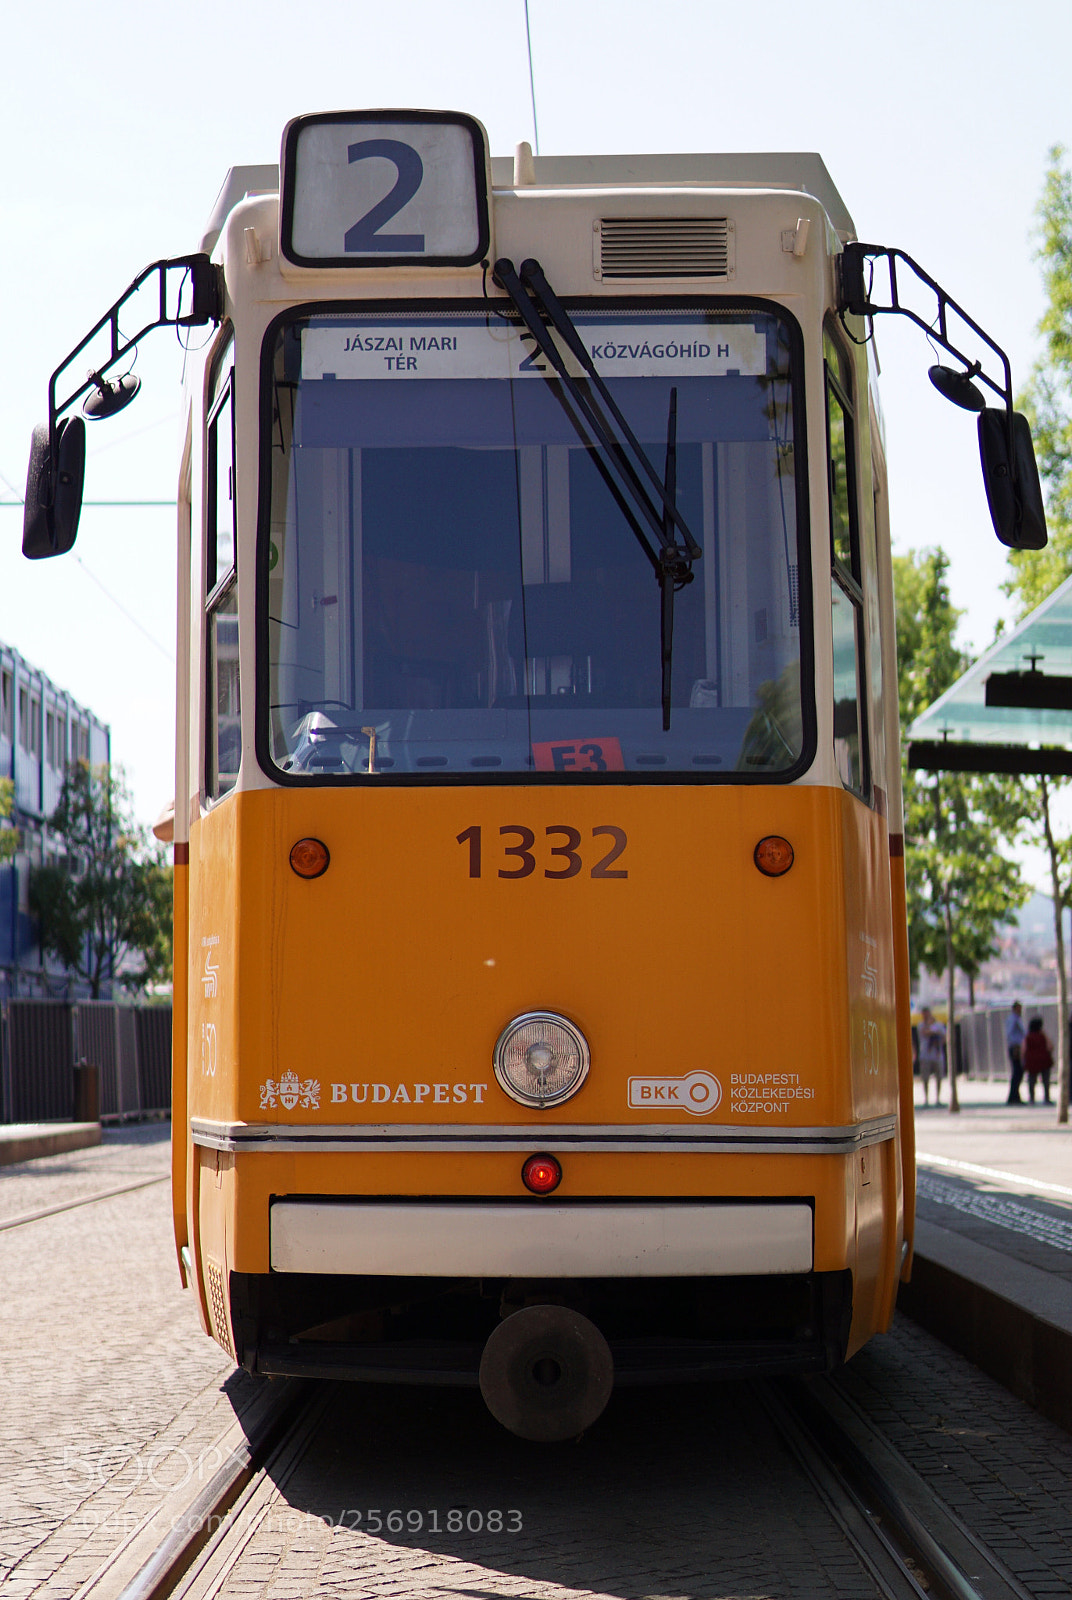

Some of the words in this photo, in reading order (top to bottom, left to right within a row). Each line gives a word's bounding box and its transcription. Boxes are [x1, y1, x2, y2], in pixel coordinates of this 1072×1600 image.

[344, 138, 425, 253] 2
[343, 334, 403, 352] JÁSZAI
[410, 337, 457, 351] MARI
[519, 332, 547, 371] 2
[591, 341, 711, 359] KÖZVÁGÓHÍD
[717, 344, 730, 357] H
[384, 353, 418, 371] TÉR
[455, 825, 629, 880] 1332
[730, 1074, 800, 1085] BUDAPESTI
[330, 1083, 488, 1104] BUDAPEST
[640, 1086, 680, 1100] BKK
[730, 1086, 815, 1099] KÖZLEKEDÉSI
[730, 1101, 790, 1113] KÖZPONT
